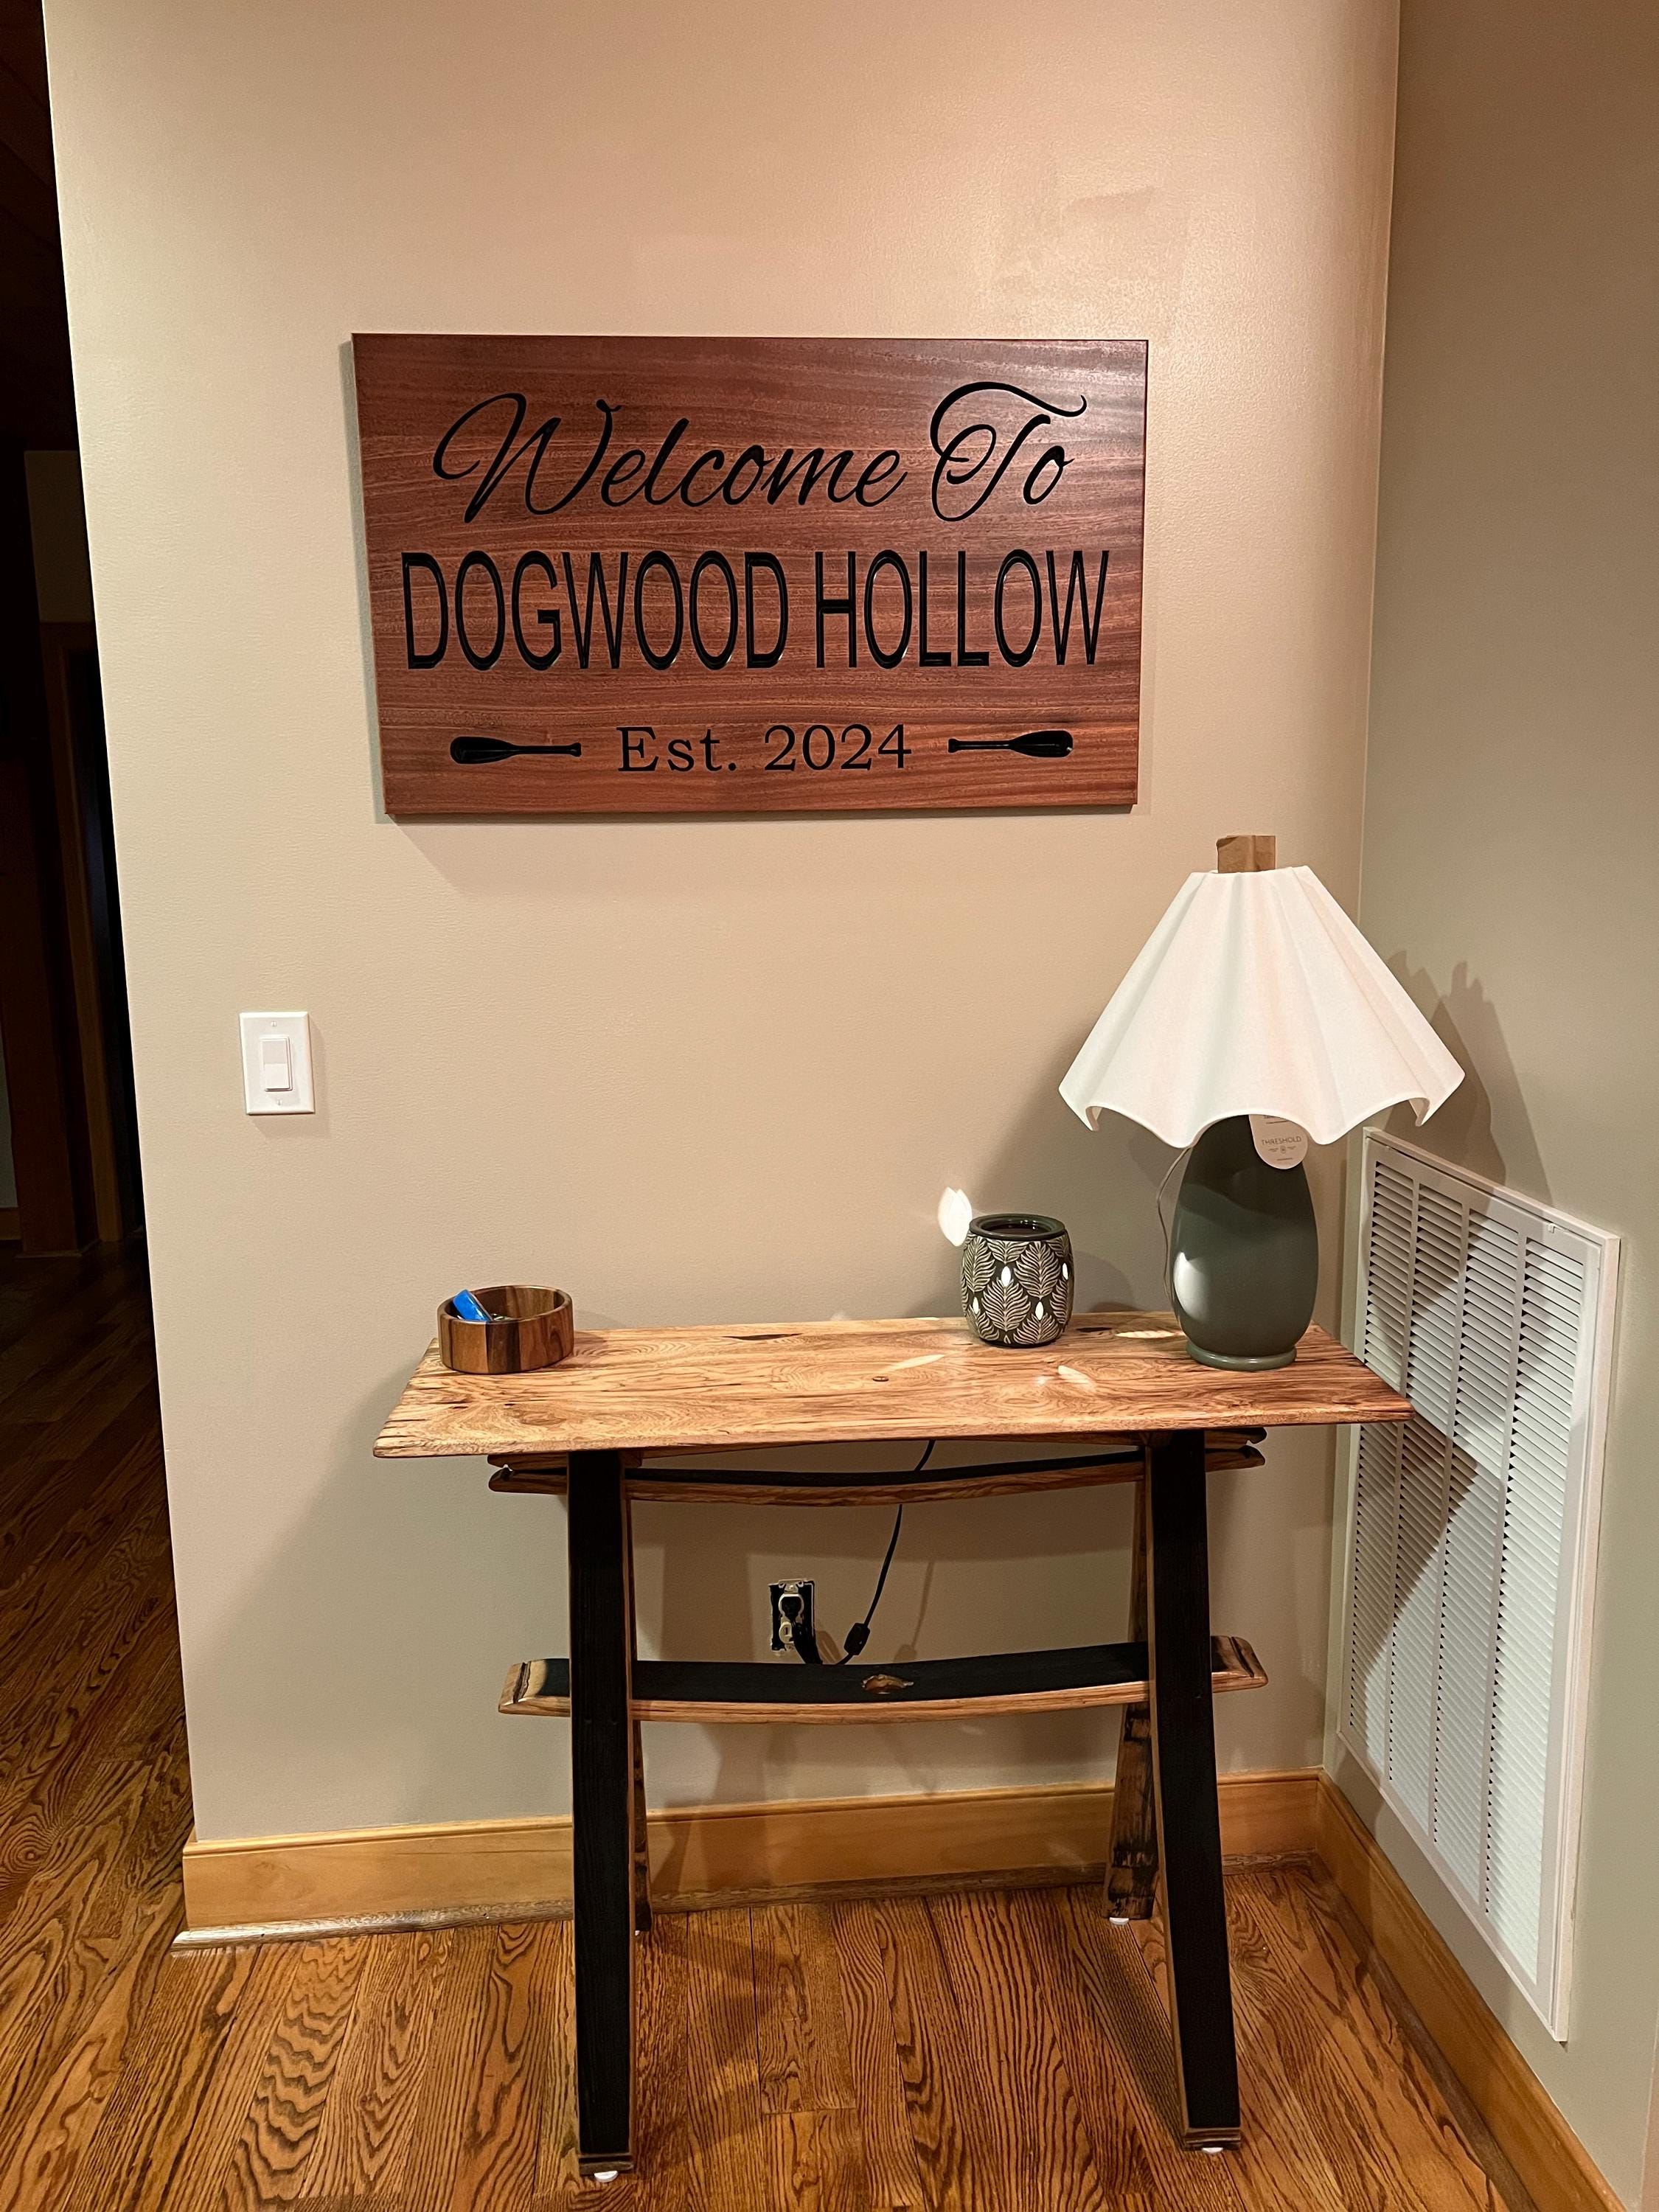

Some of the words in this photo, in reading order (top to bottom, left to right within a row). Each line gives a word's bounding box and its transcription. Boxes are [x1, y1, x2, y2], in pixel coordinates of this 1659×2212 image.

[432, 392, 908, 523] Welcome
[930, 381, 1087, 521] To
[401, 550, 789, 670] DOGWOOD
[815, 549, 1109, 669] HOLLOW
[616, 726, 737, 772] Est.
[764, 723, 912, 771] 2024
[1262, 1136, 1301, 1146] THRESHOLD
